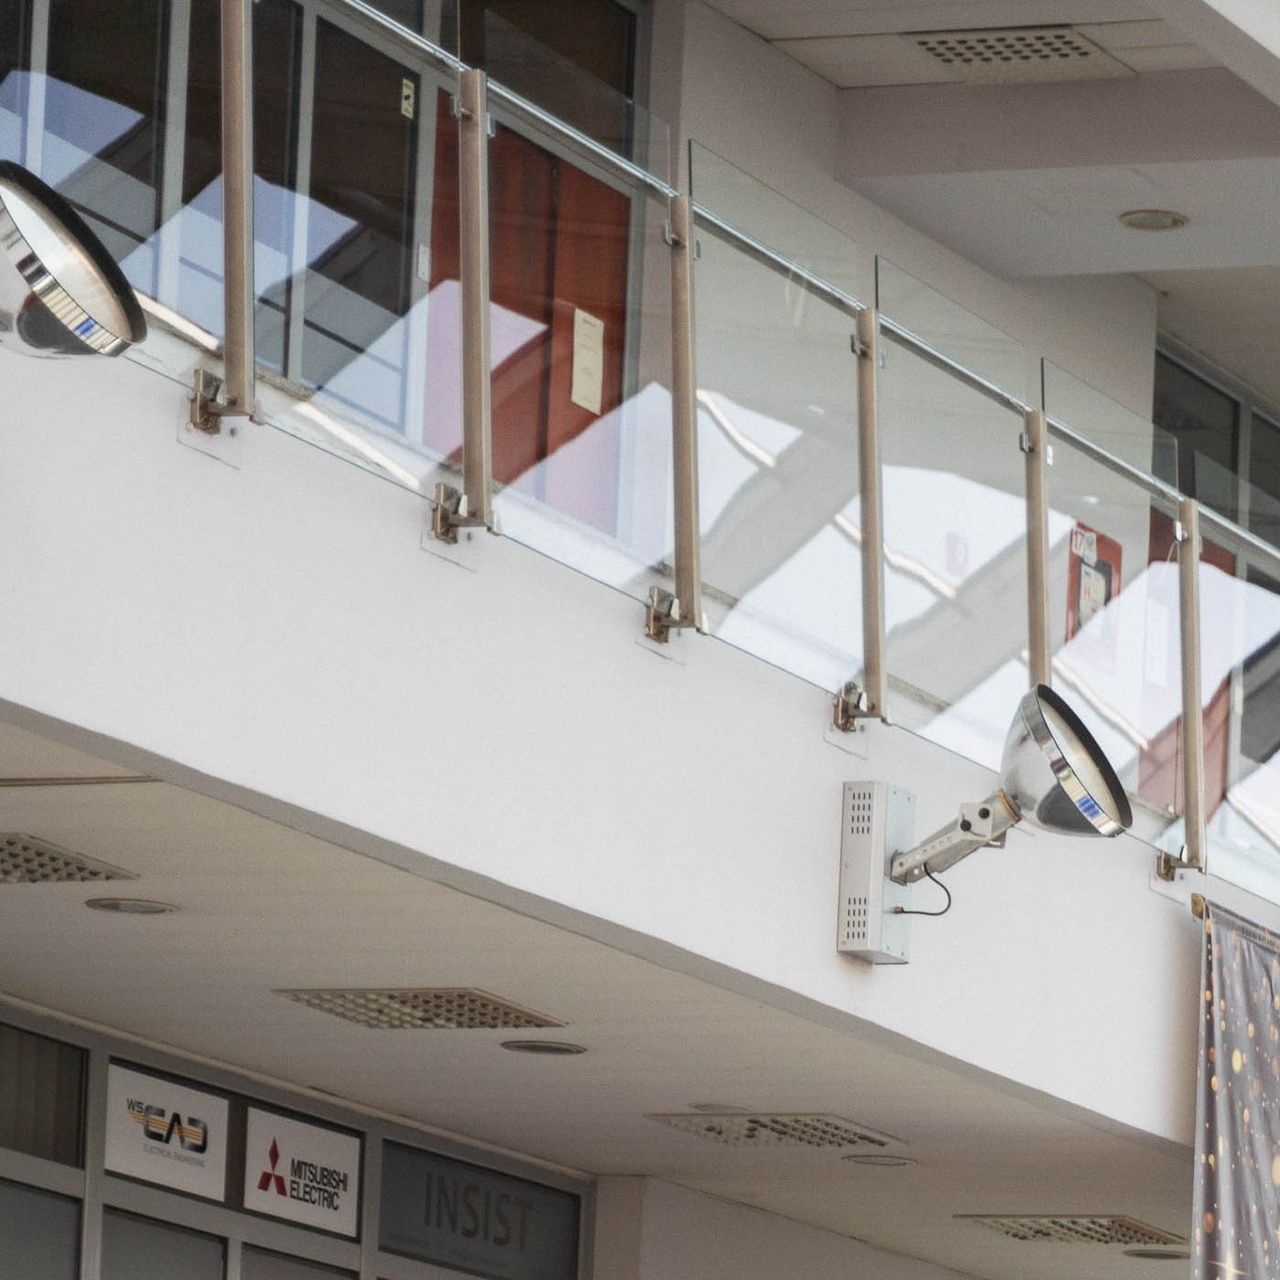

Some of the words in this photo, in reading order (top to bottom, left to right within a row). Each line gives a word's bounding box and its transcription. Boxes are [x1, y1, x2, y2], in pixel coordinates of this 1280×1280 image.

[291, 1157, 348, 1193] MITSUBISHI
[290, 1181, 340, 1211] ELECTRIC
[424, 1171, 532, 1252] INSIST
